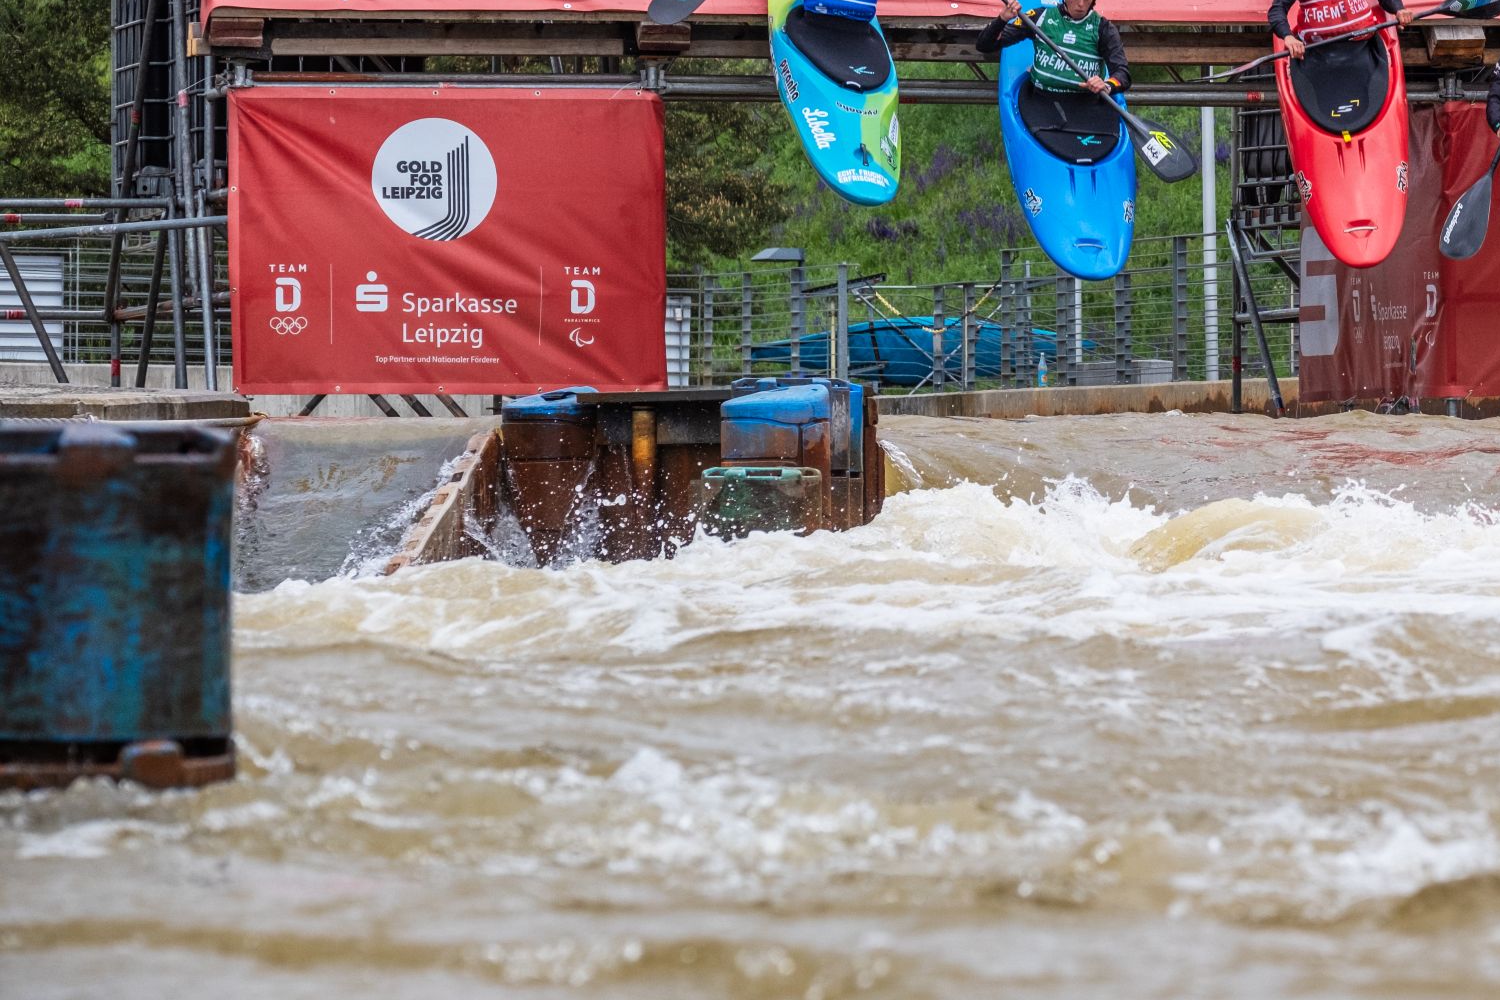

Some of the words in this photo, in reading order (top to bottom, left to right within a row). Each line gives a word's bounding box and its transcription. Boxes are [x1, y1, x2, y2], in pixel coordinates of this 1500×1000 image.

[1304, 1, 1347, 23] X-TREME
[779, 58, 800, 101] pyranha
[802, 107, 836, 149] Libella
[397, 161, 442, 173] GOLD
[410, 174, 442, 186] FOR
[382, 187, 442, 199] LEIPZIG
[269, 264, 307, 272] TEAM
[564, 267, 600, 275] TEAM
[402, 292, 518, 317] Sparkasse
[402, 323, 482, 348] Leipzig
[375, 356, 388, 364] Top
[389, 356, 415, 364] Partner
[417, 356, 430, 364] und
[432, 356, 469, 364] Nationaler
[471, 356, 500, 364] Förderer
